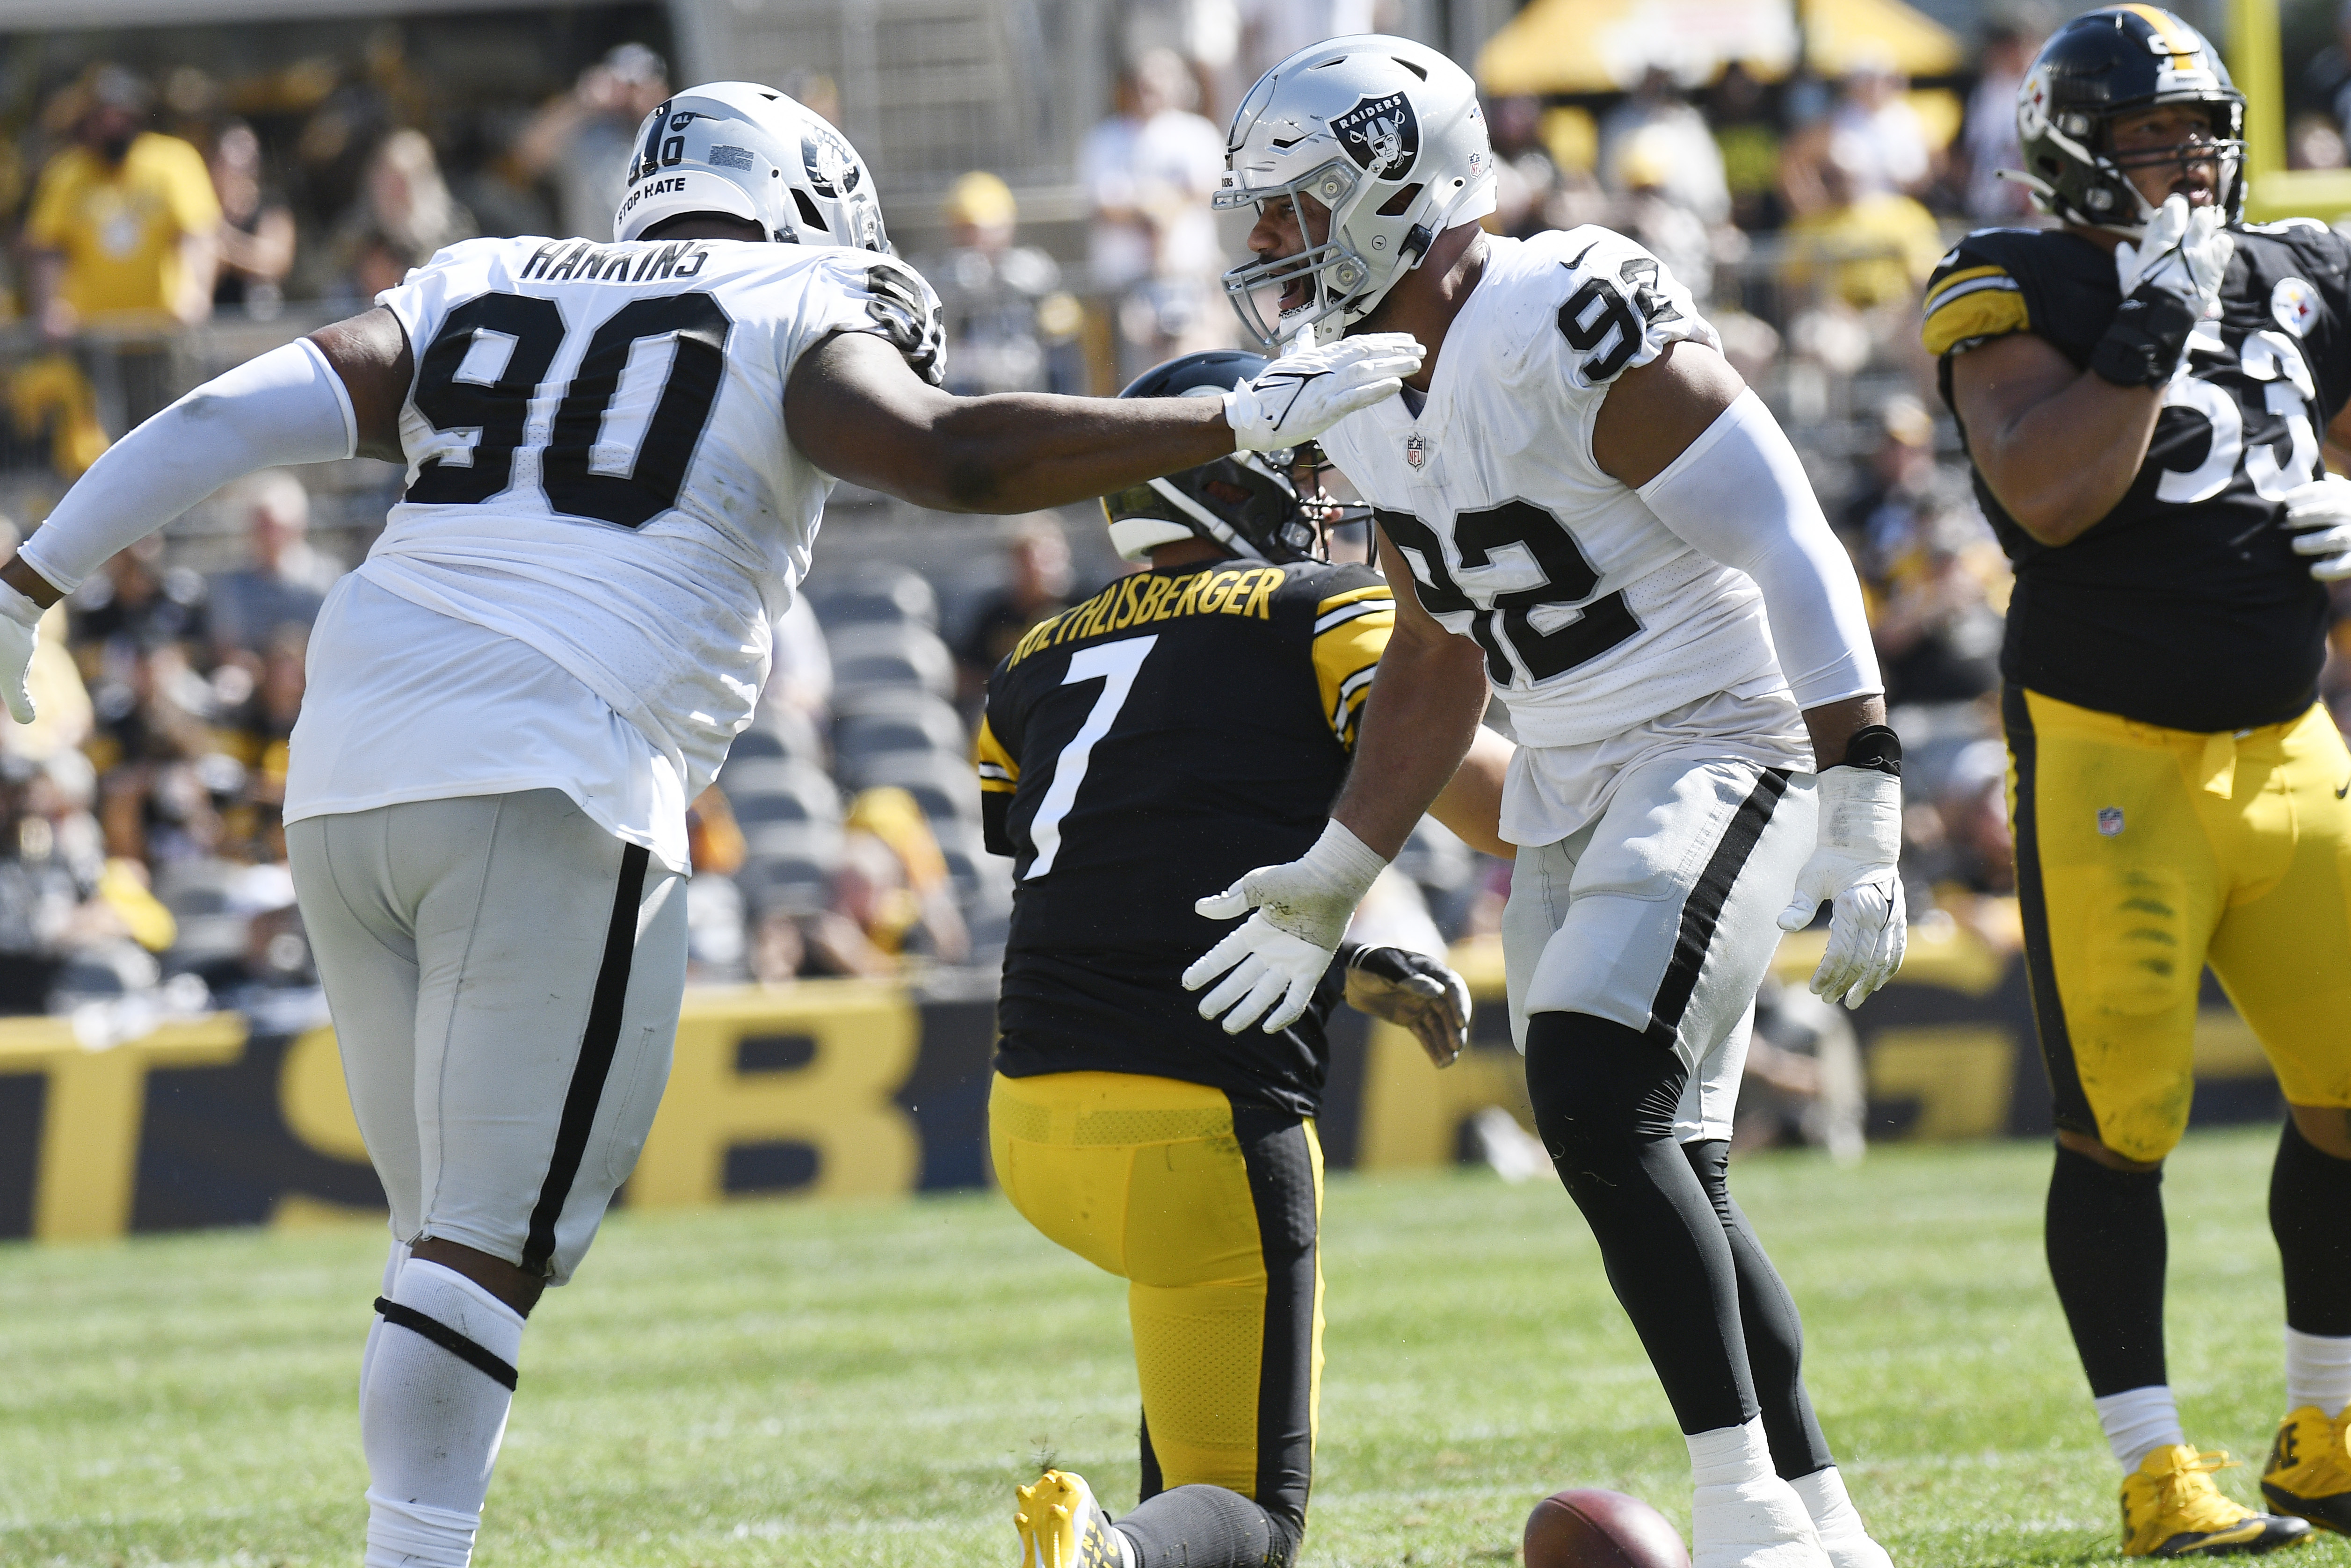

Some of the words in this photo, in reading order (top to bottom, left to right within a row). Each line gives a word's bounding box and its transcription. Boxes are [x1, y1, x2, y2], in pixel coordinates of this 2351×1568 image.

[672, 116, 690, 125] AL
[1338, 95, 1401, 130] RAIDERS
[1471, 163, 1481, 174] NFL
[618, 190, 640, 225] STOP
[644, 177, 686, 199] HATE
[519, 240, 721, 282] HANKINS
[1555, 257, 1684, 385] 92
[403, 289, 738, 532] 90
[2155, 320, 2320, 504] 53
[1409, 450, 1421, 464] NFL
[1373, 495, 1647, 690] 92
[1022, 634, 1159, 882] 7
